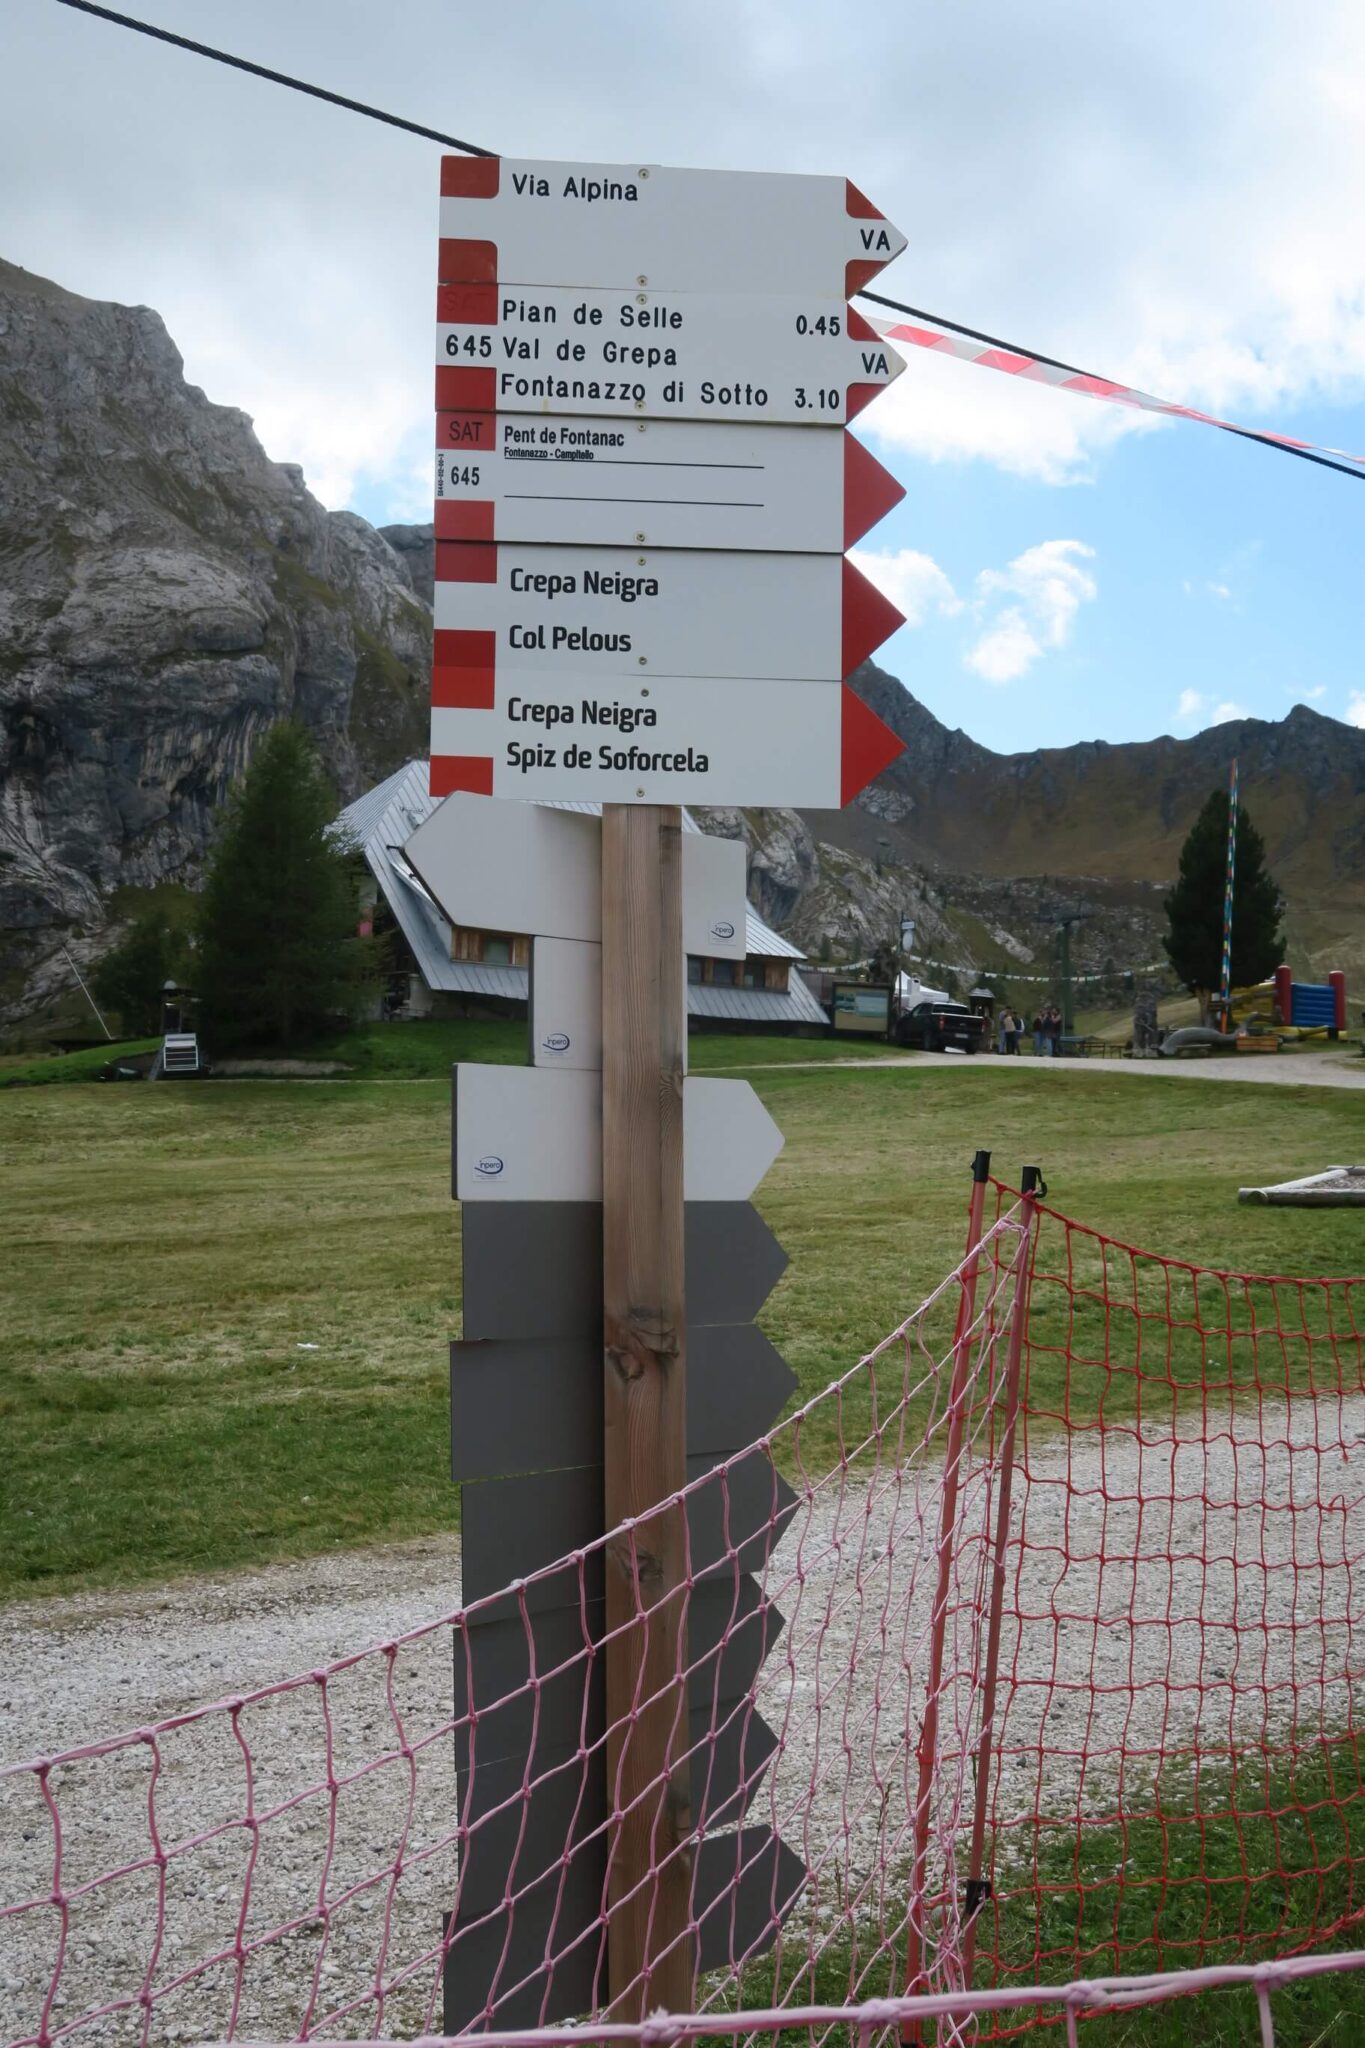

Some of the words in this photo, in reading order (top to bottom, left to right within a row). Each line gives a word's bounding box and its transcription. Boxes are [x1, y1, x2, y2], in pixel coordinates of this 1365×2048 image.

[513, 174, 550, 197] Via
[564, 177, 638, 203] Alpina
[861, 229, 891, 251] VA
[503, 300, 558, 323] Pian
[574, 304, 603, 326] de
[621, 305, 683, 329] Selle
[796, 315, 841, 337] 0.45
[446, 335, 492, 358] 645
[503, 337, 541, 360] Val
[557, 340, 586, 362] de
[603, 342, 677, 369] Grepa
[862, 353, 889, 375] VA
[502, 374, 646, 402] Fontanazzo
[663, 381, 684, 403] di
[701, 382, 768, 407] Sotto
[795, 389, 840, 410] 3.10
[449, 421, 483, 442] SAT
[505, 426, 536, 444] Pent
[540, 427, 557, 444] de
[561, 428, 625, 447] Fontanac
[505, 447, 549, 459] Fontanazzo
[555, 448, 594, 461] Campitello
[451, 467, 480, 486] 645
[511, 568, 576, 600] Crepa
[584, 571, 659, 603] Neigra
[510, 625, 546, 650] Col
[553, 627, 632, 652] Pelous
[509, 698, 574, 730] Crepa
[582, 701, 657, 733] Neigra
[507, 742, 557, 774] Spiz
[564, 744, 592, 769] de
[599, 746, 709, 773] Soforcela
